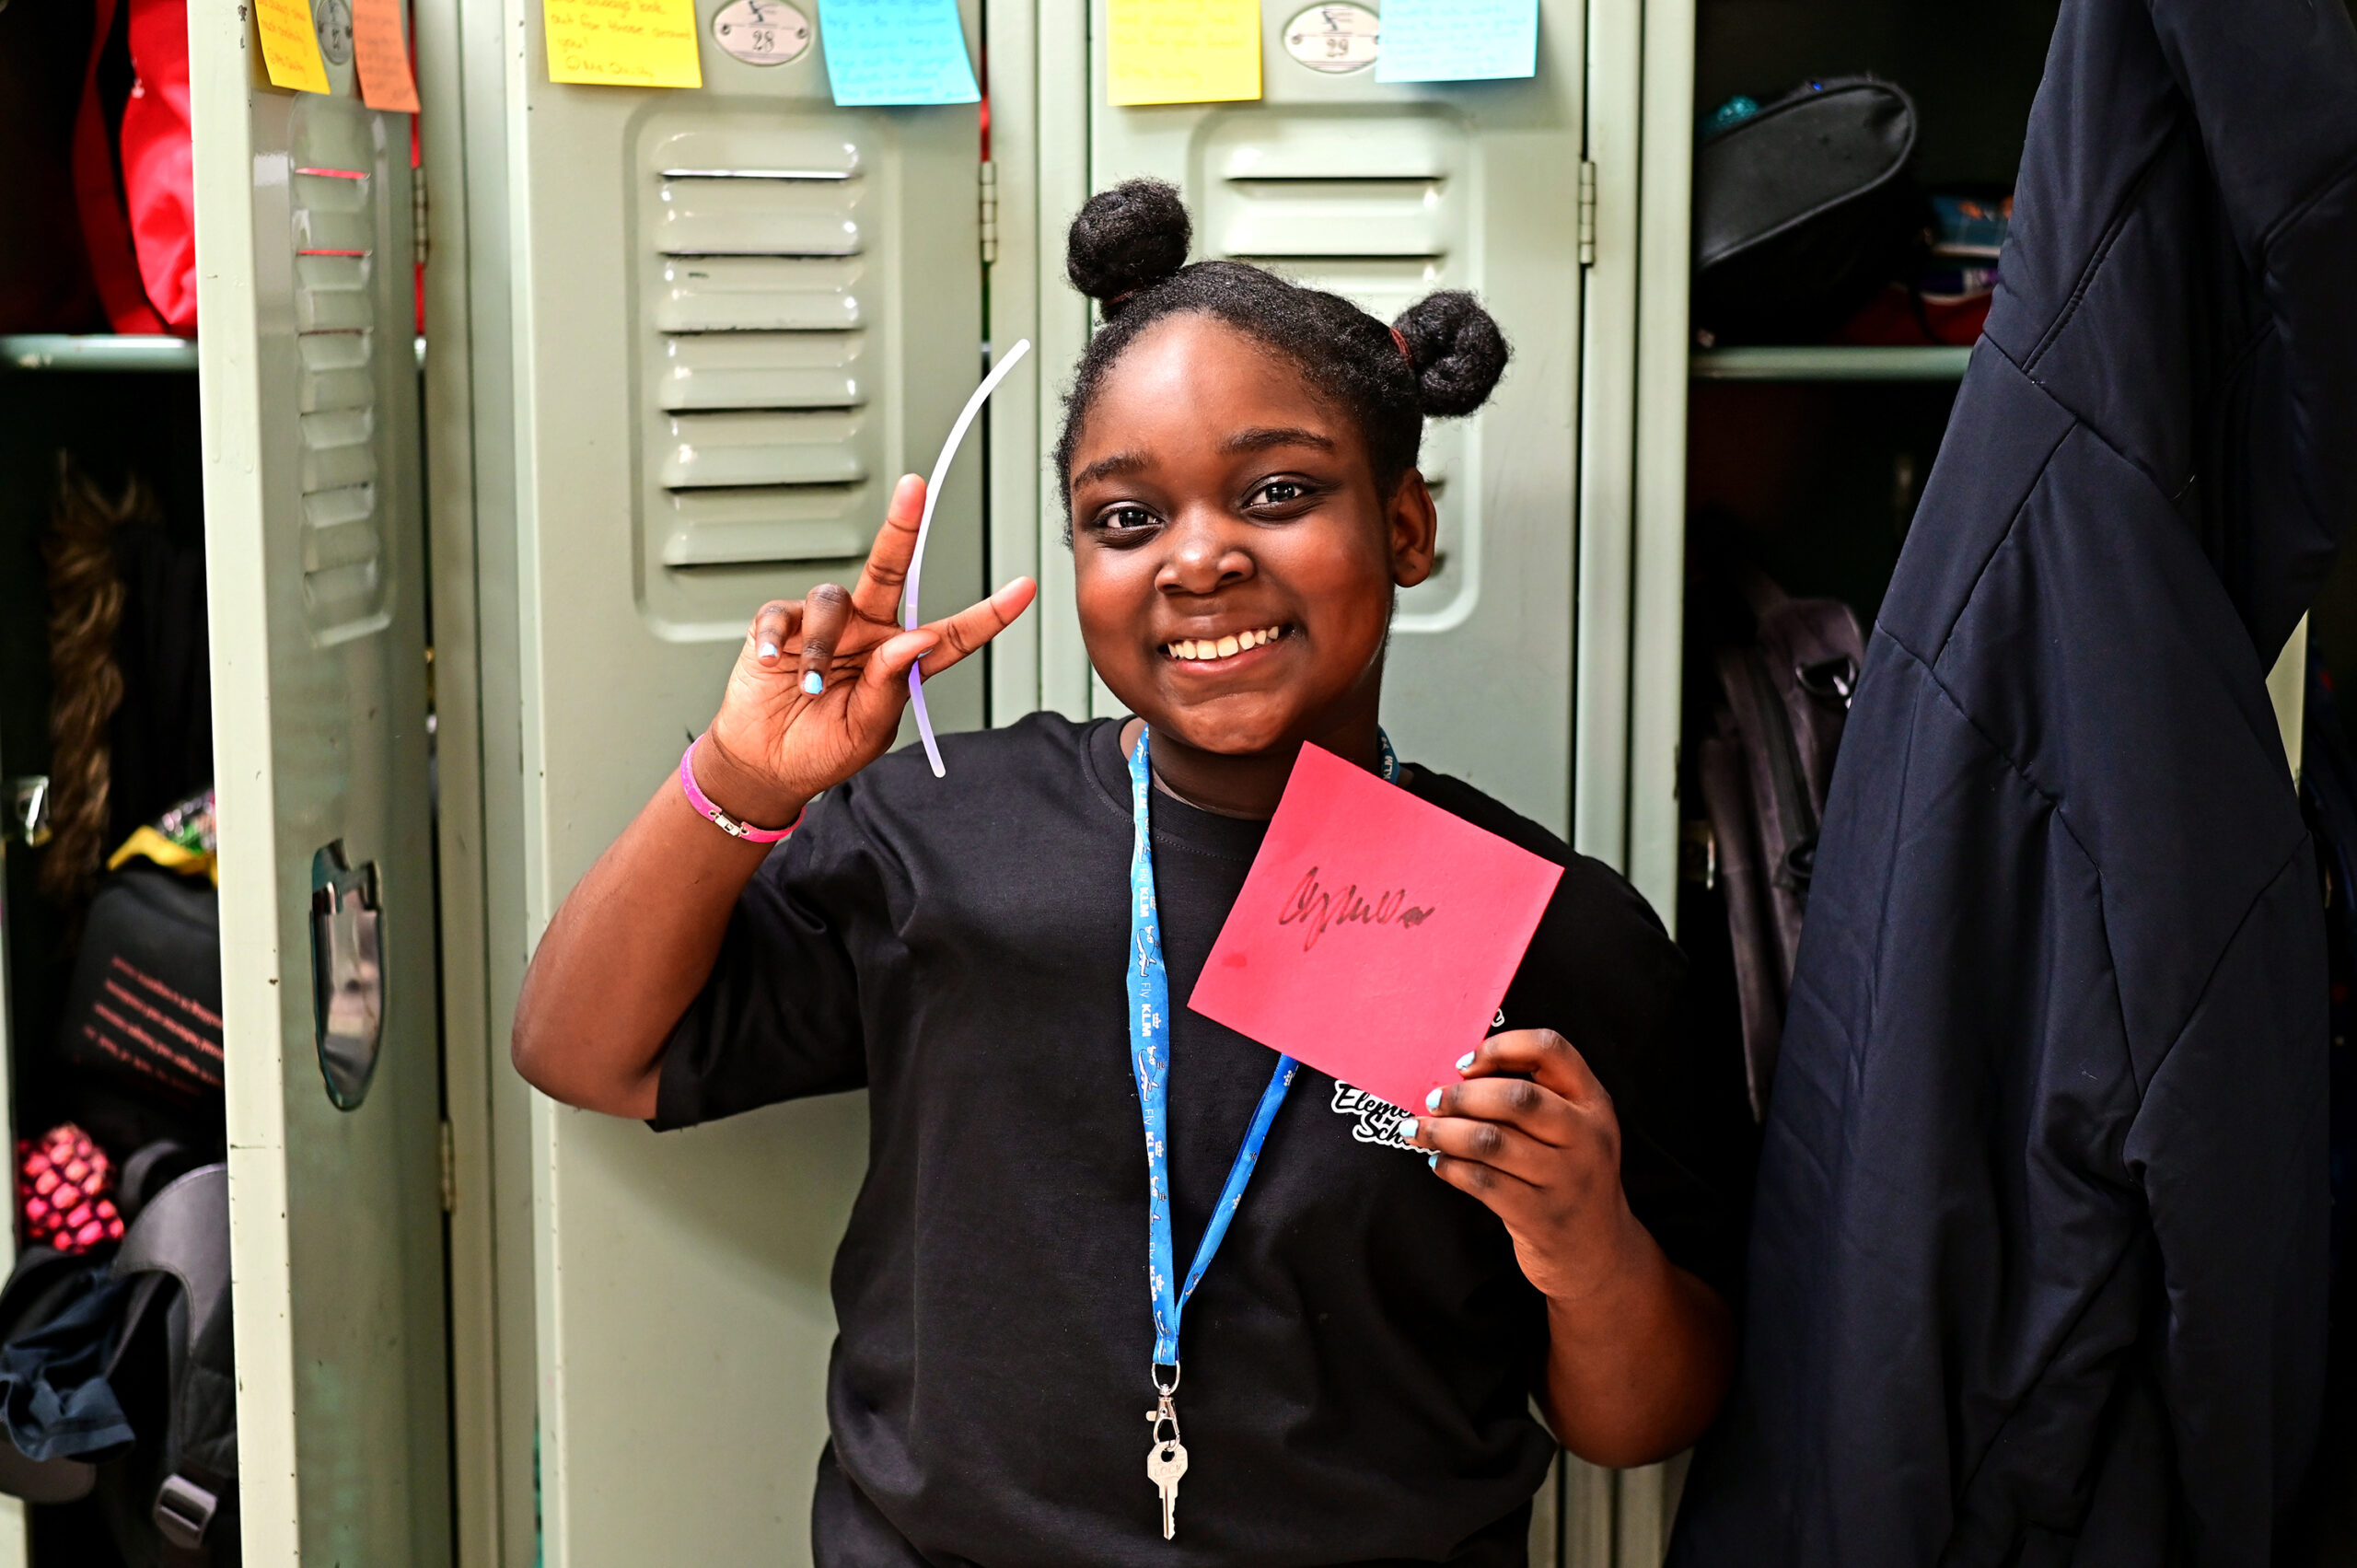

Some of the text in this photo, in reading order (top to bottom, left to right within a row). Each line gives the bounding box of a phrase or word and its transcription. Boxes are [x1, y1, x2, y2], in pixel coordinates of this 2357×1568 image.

[751, 29, 774, 52] 28
[1138, 783, 1148, 809] KLM
[1139, 887, 1150, 918] KLM
[1138, 982, 1152, 1038] Fly KLM
[1144, 1109, 1155, 1167] Fly KLM
